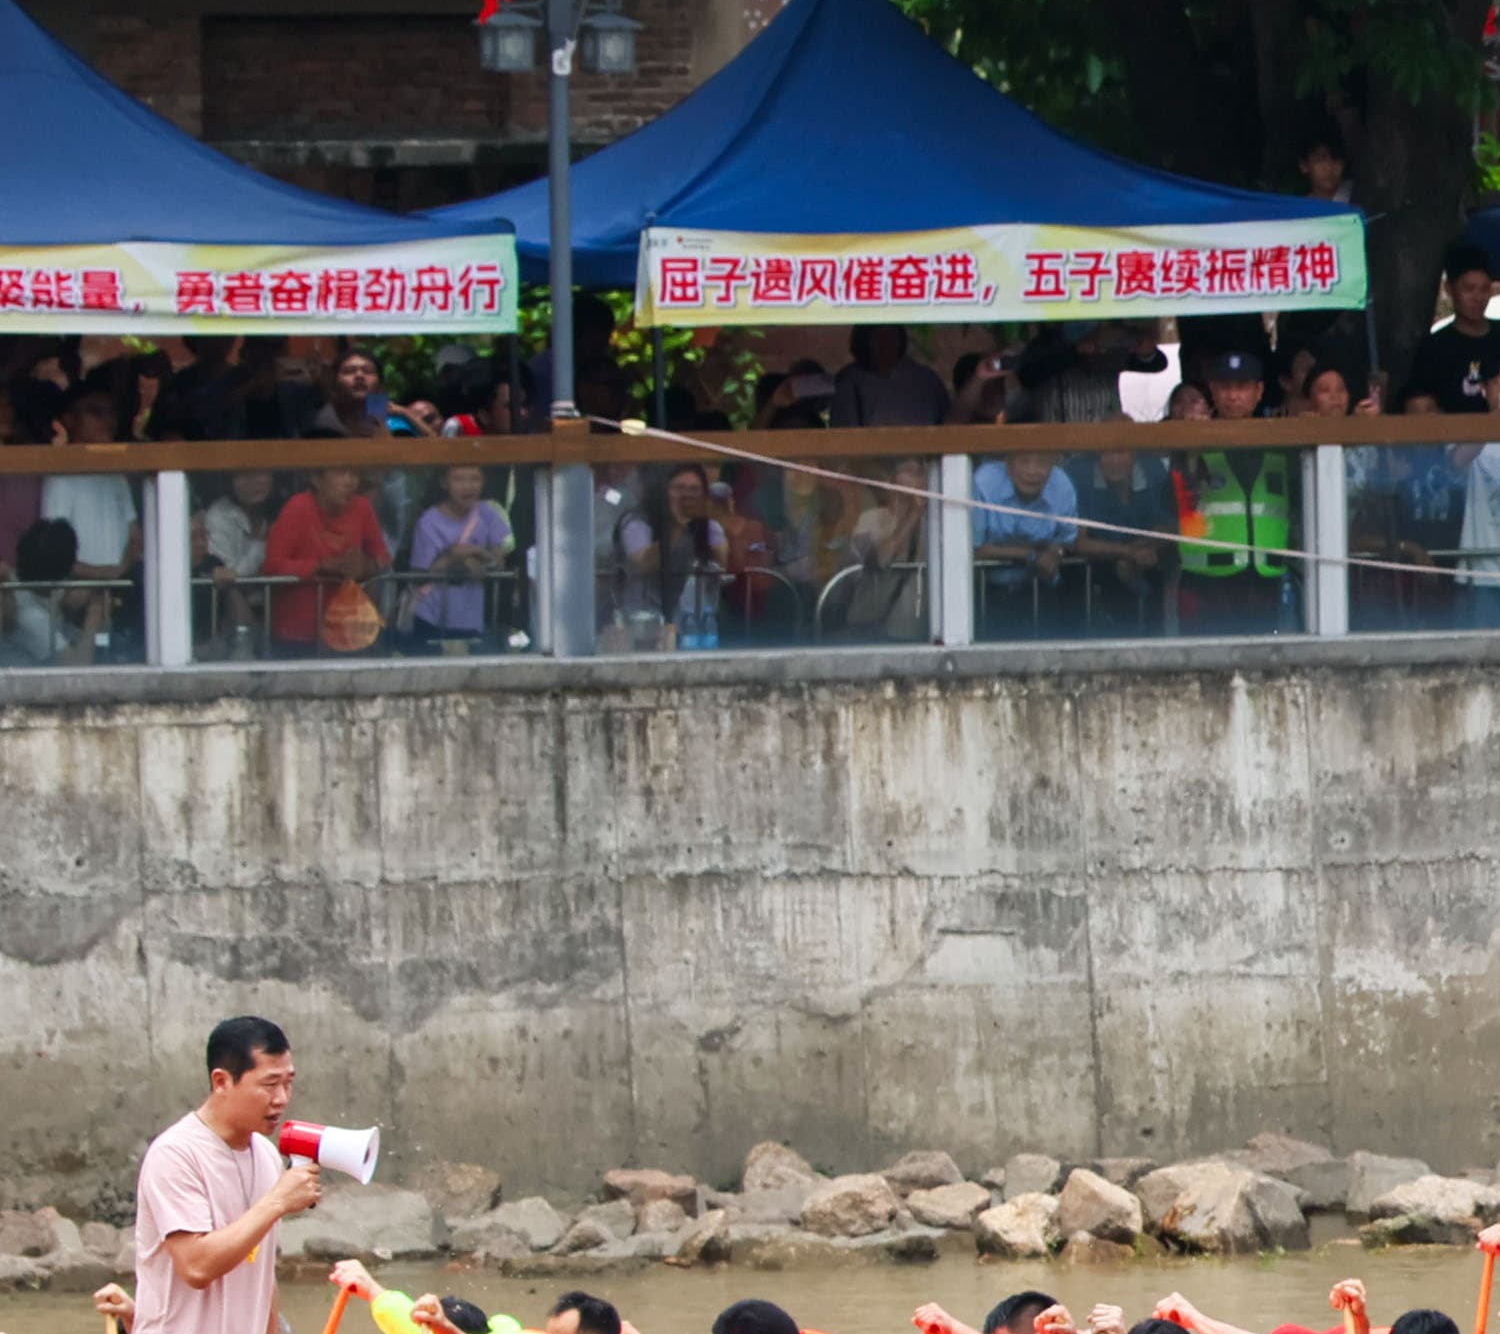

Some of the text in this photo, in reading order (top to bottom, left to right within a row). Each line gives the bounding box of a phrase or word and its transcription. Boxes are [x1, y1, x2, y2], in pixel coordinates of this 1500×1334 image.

[660, 242, 1338, 304] 屈子遗风催奋进，五子赓续振精神
